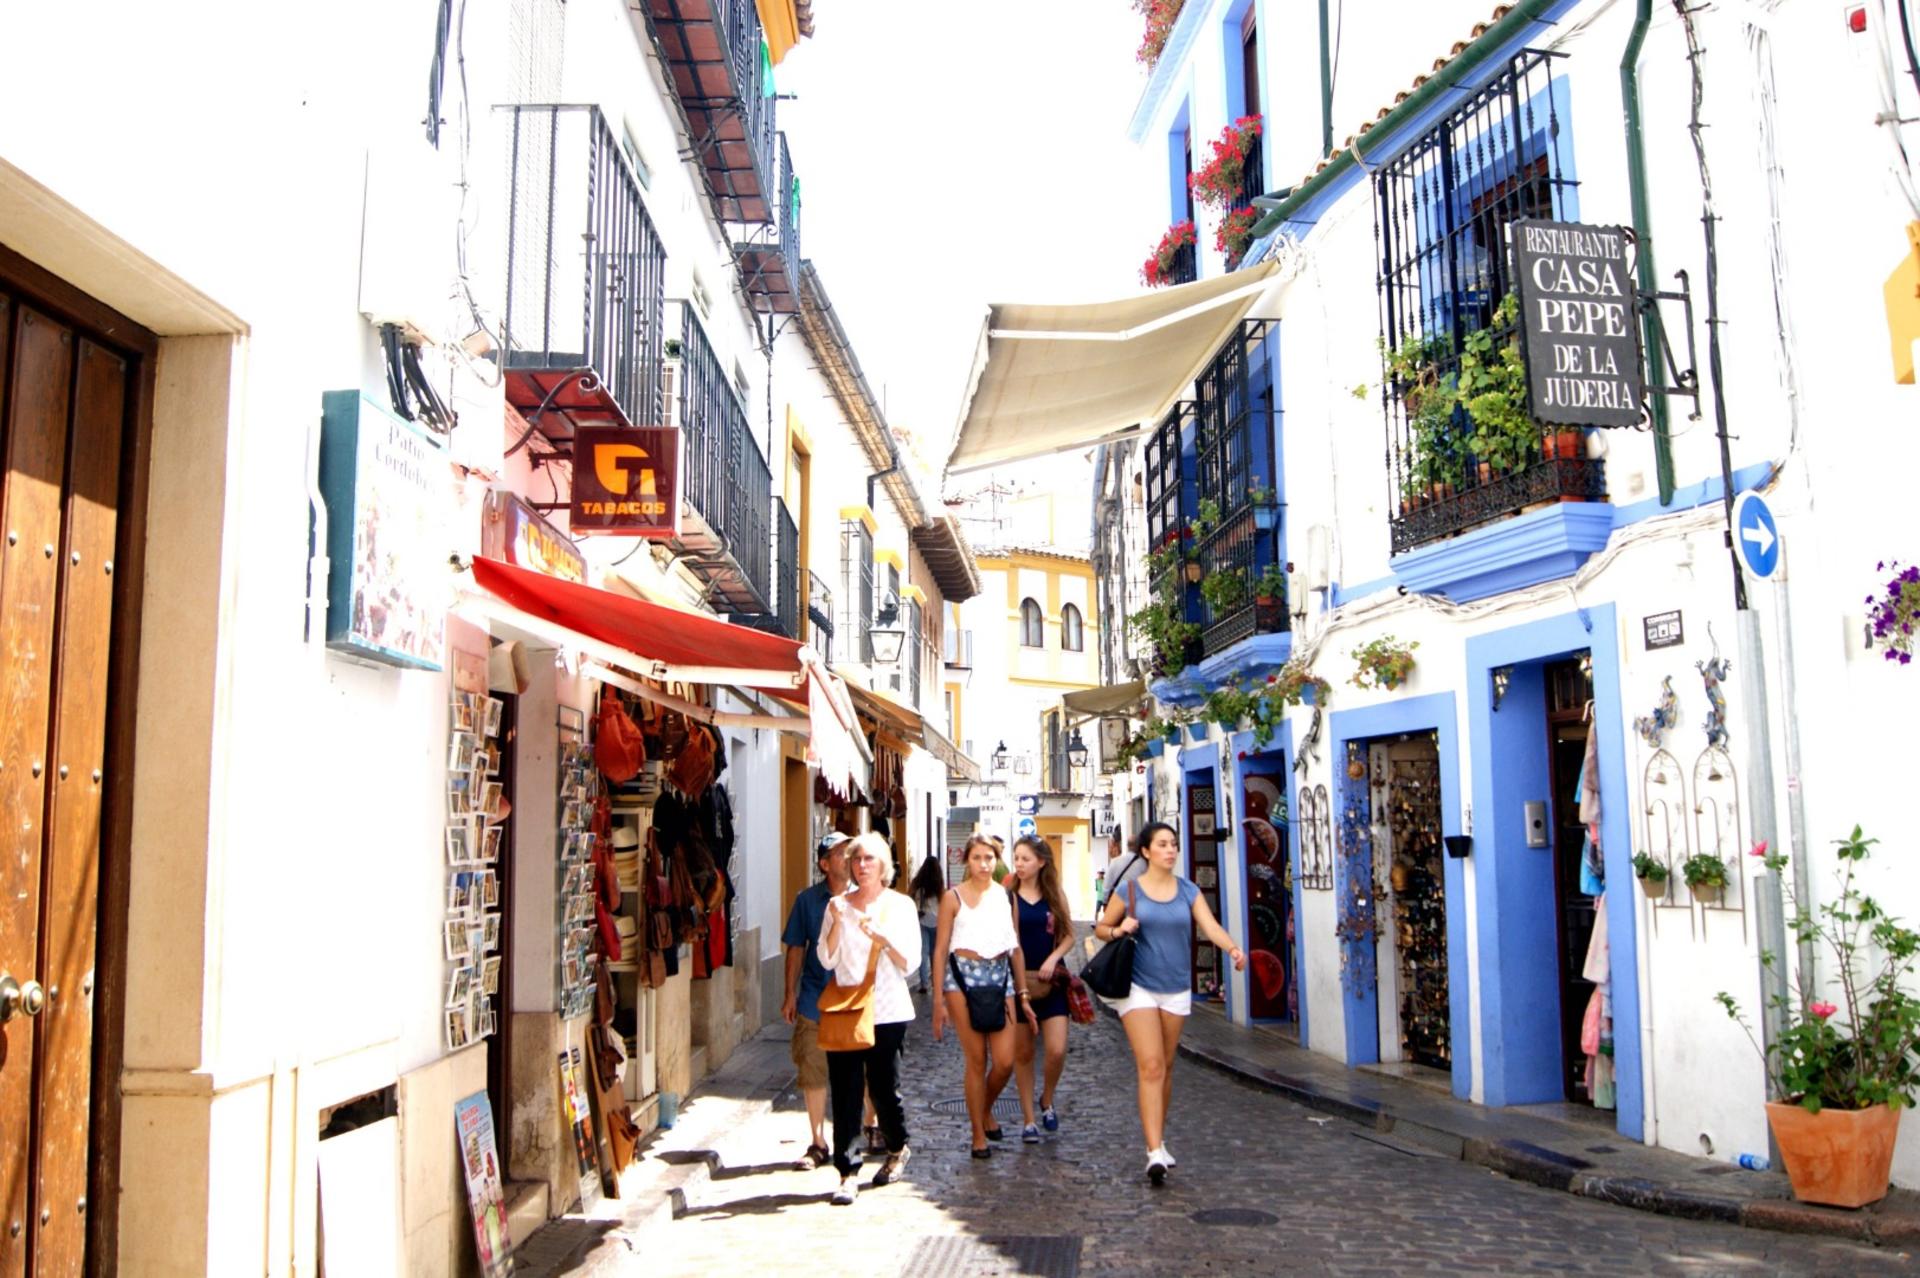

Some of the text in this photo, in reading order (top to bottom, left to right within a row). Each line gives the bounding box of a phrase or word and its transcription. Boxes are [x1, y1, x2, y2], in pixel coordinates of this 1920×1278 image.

[1525, 226, 1621, 260] RESTAURANTE
[1532, 257, 1623, 297] CASA
[1537, 298, 1627, 337] PEPE
[1553, 343, 1620, 376] DE LA
[1543, 377, 1635, 410] JUDERIA
[375, 442, 436, 496] Cordob
[581, 502, 666, 515] TABACOS
